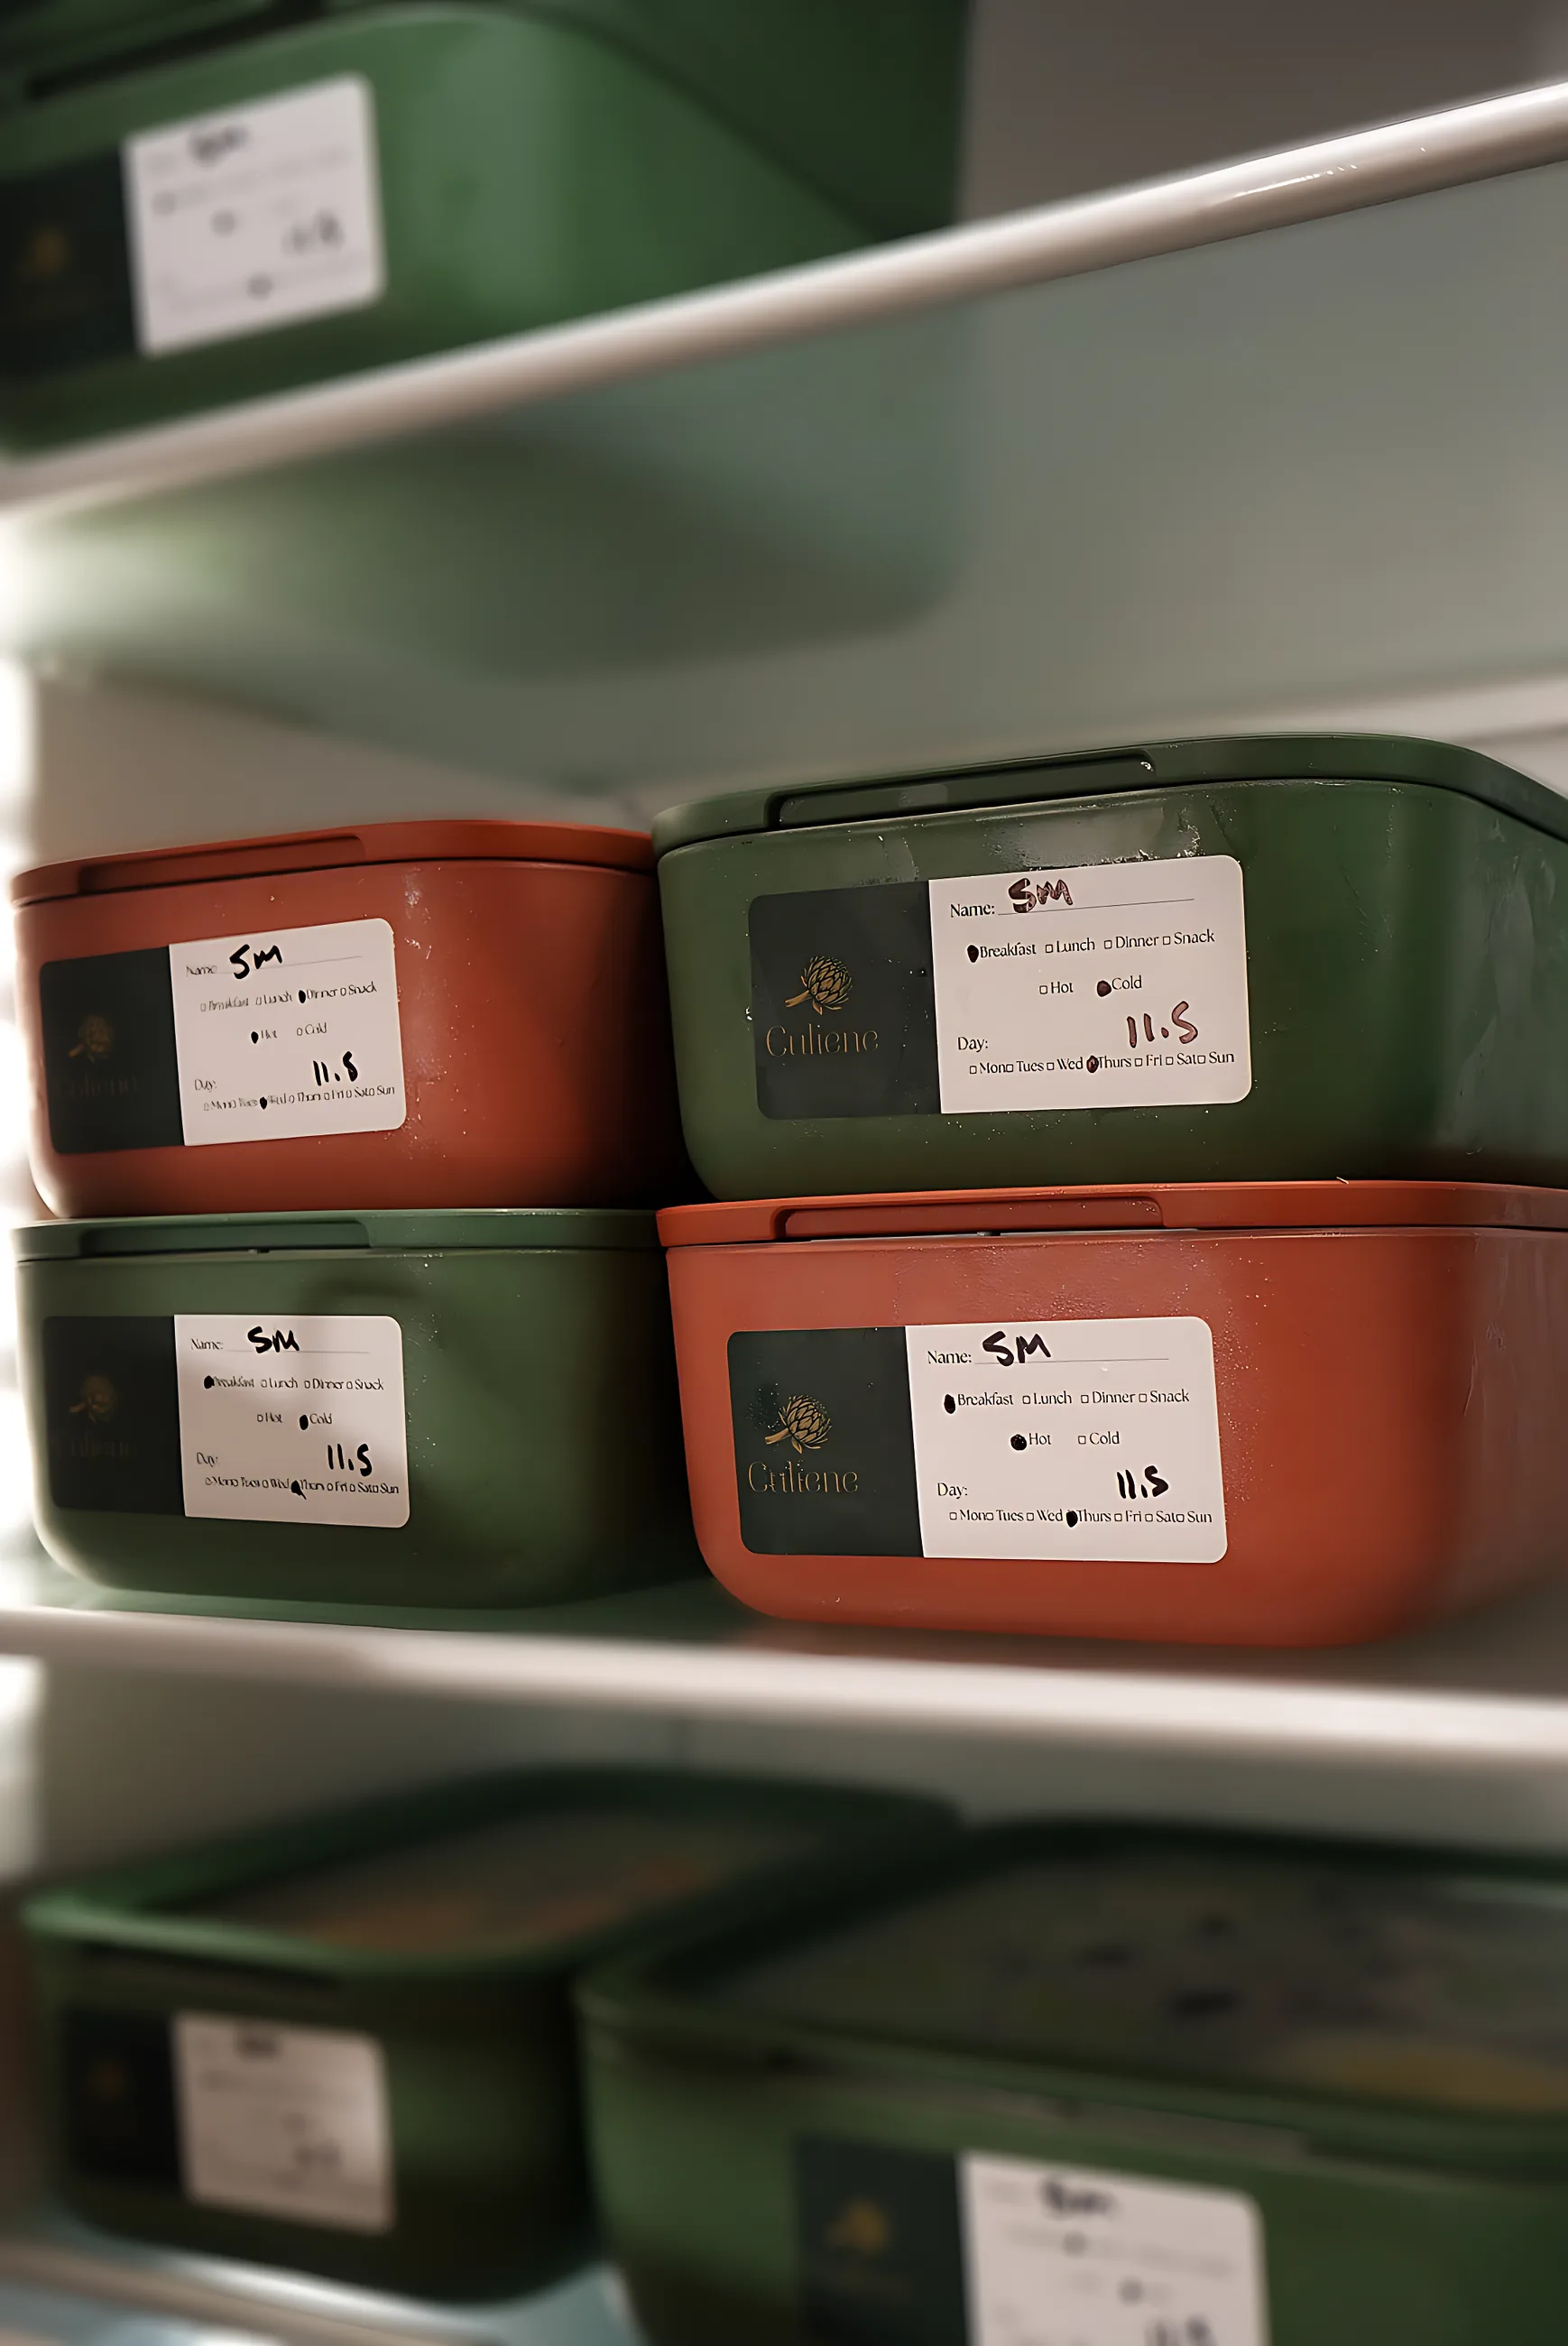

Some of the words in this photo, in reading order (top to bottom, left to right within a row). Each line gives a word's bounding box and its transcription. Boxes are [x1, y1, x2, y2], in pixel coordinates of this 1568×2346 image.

[950, 902, 995, 918] Name:
[980, 941, 1037, 959] Breakfast
[1056, 937, 1095, 953] Lunch
[1115, 935, 1159, 949] Dinner
[1174, 928, 1215, 945] Snack
[1051, 981, 1074, 994] Hot
[1111, 975, 1142, 991] Cold
[957, 1037, 989, 1053] Day:
[980, 1062, 1006, 1075] Mon
[1016, 1060, 1045, 1073] Tues
[1056, 1057, 1084, 1071] Wed
[1098, 1056, 1132, 1069] Thurs
[1146, 1054, 1163, 1067] Fri
[1176, 1052, 1197, 1066] Sat
[1209, 1051, 1234, 1064] Sun
[927, 1350, 972, 1365] Name:
[957, 1392, 1014, 1406] Breakfast
[1033, 1390, 1072, 1405] Lunch
[1093, 1390, 1136, 1405] Dinner
[1149, 1389, 1190, 1403] Snack
[1028, 1433, 1051, 1445] Hot
[1089, 1431, 1120, 1445] Cold
[937, 1482, 968, 1500] Day:
[960, 1510, 987, 1521] Mon
[996, 1510, 1024, 1521] Tues
[1037, 1510, 1063, 1521] Wed
[1078, 1510, 1111, 1522] Thurs
[1126, 1510, 1142, 1522] Fri
[1156, 1510, 1177, 1523] Sat
[1187, 1511, 1213, 1523] Sun
